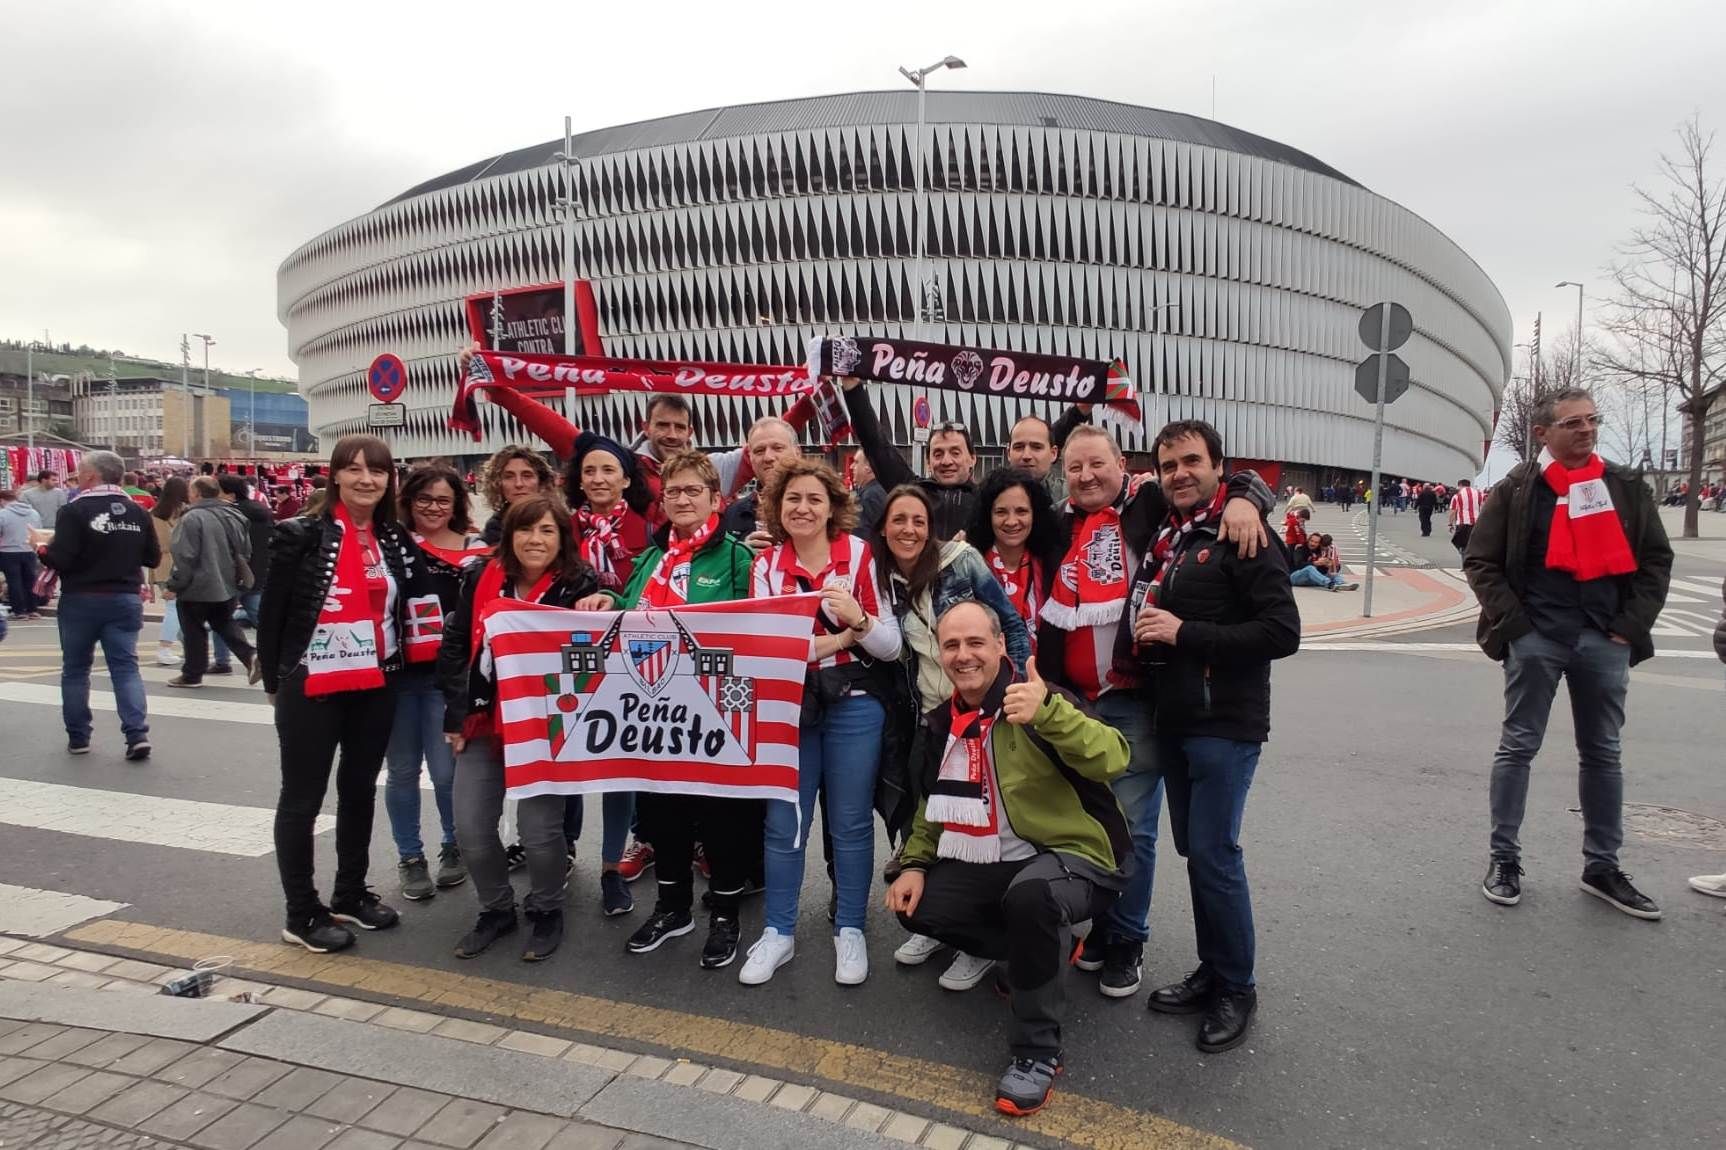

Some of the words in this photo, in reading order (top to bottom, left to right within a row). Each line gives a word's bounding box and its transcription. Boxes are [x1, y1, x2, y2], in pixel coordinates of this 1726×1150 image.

[508, 317, 549, 339] ATHLETIC
[517, 338, 555, 355] CONTRA
[493, 356, 606, 384] Peña
[674, 366, 817, 393] Deusto
[871, 343, 946, 384] Peña
[988, 356, 1096, 398] Deusto
[619, 692, 688, 723] Peña
[583, 709, 725, 757] Deusto
